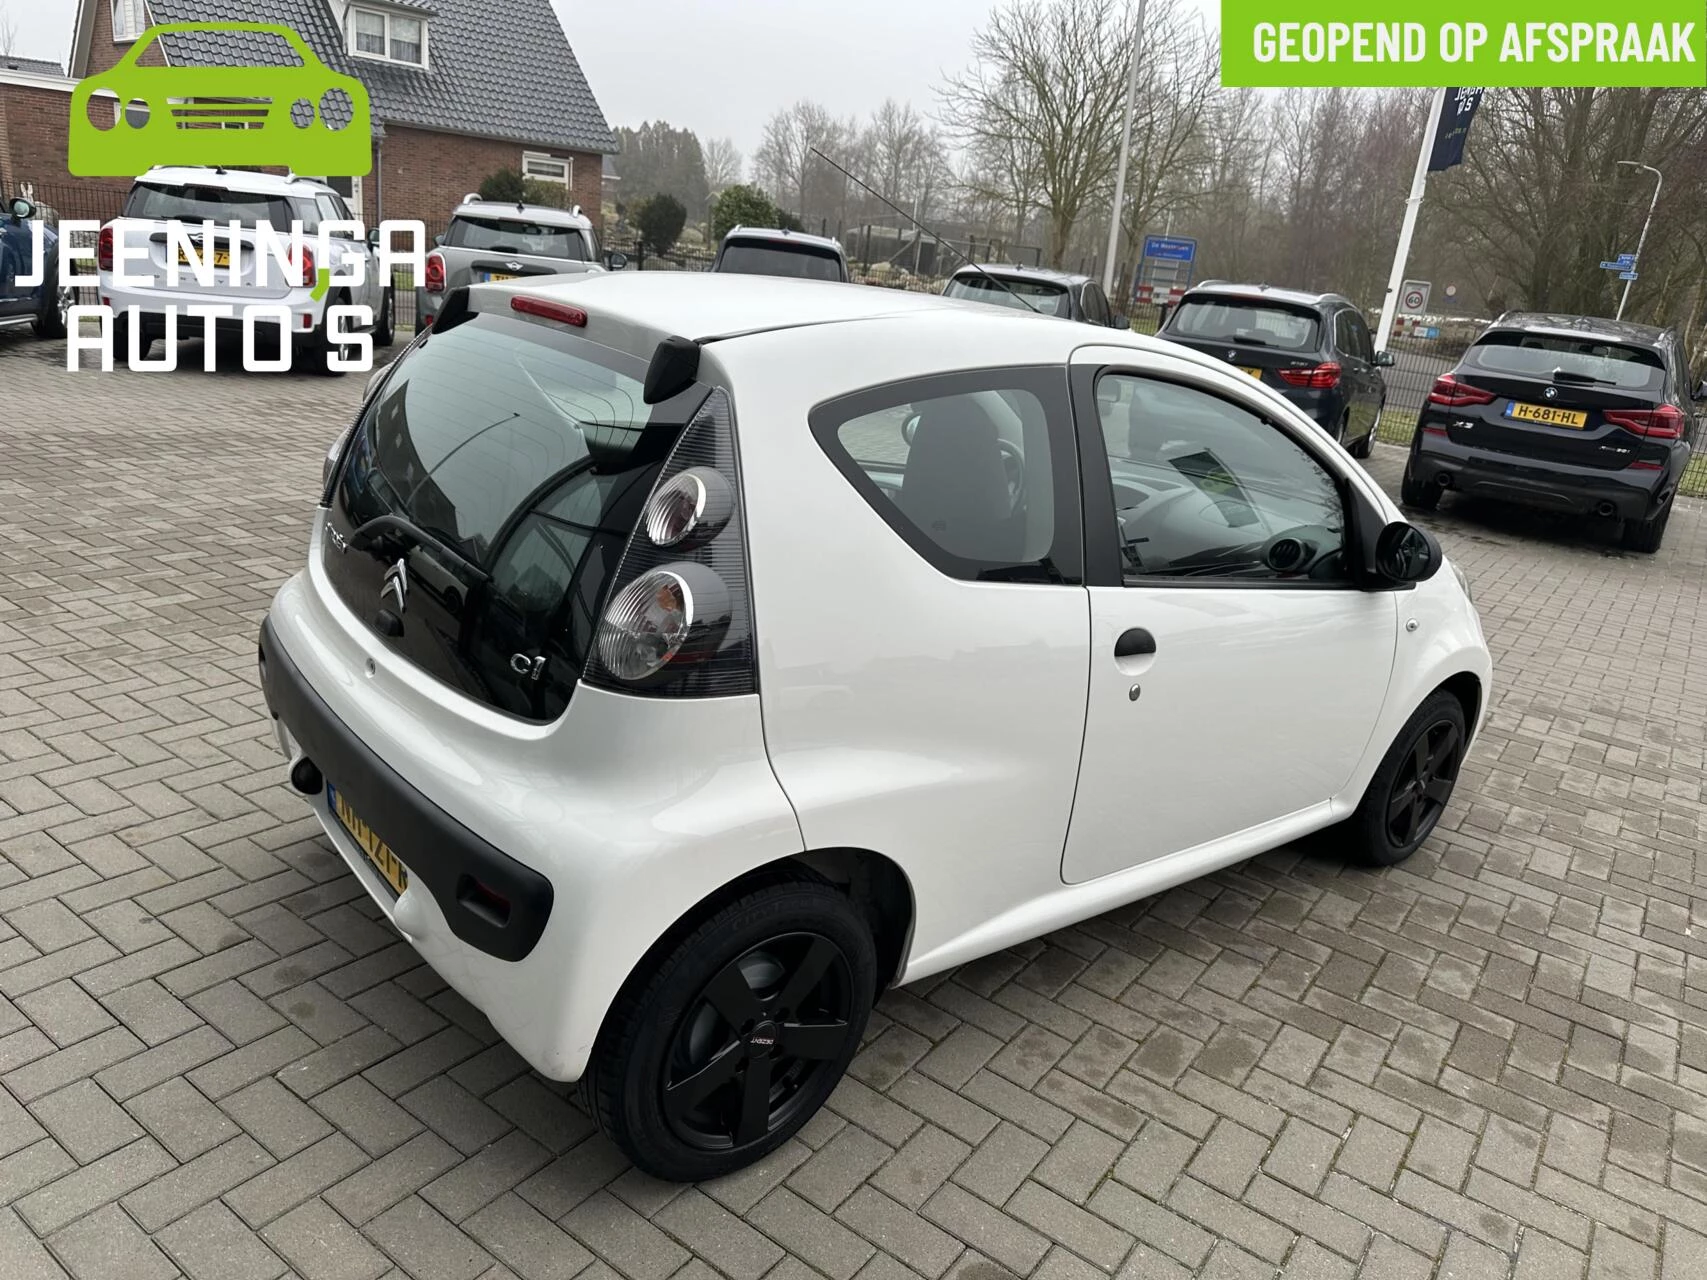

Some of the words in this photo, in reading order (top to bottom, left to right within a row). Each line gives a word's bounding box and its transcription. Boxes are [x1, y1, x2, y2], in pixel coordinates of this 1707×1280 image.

[1409, 296, 1420, 304] 60
[1517, 405, 1579, 425] H-681-HL
[1452, 421, 1474, 429] X3
[511, 653, 546, 680] C1
